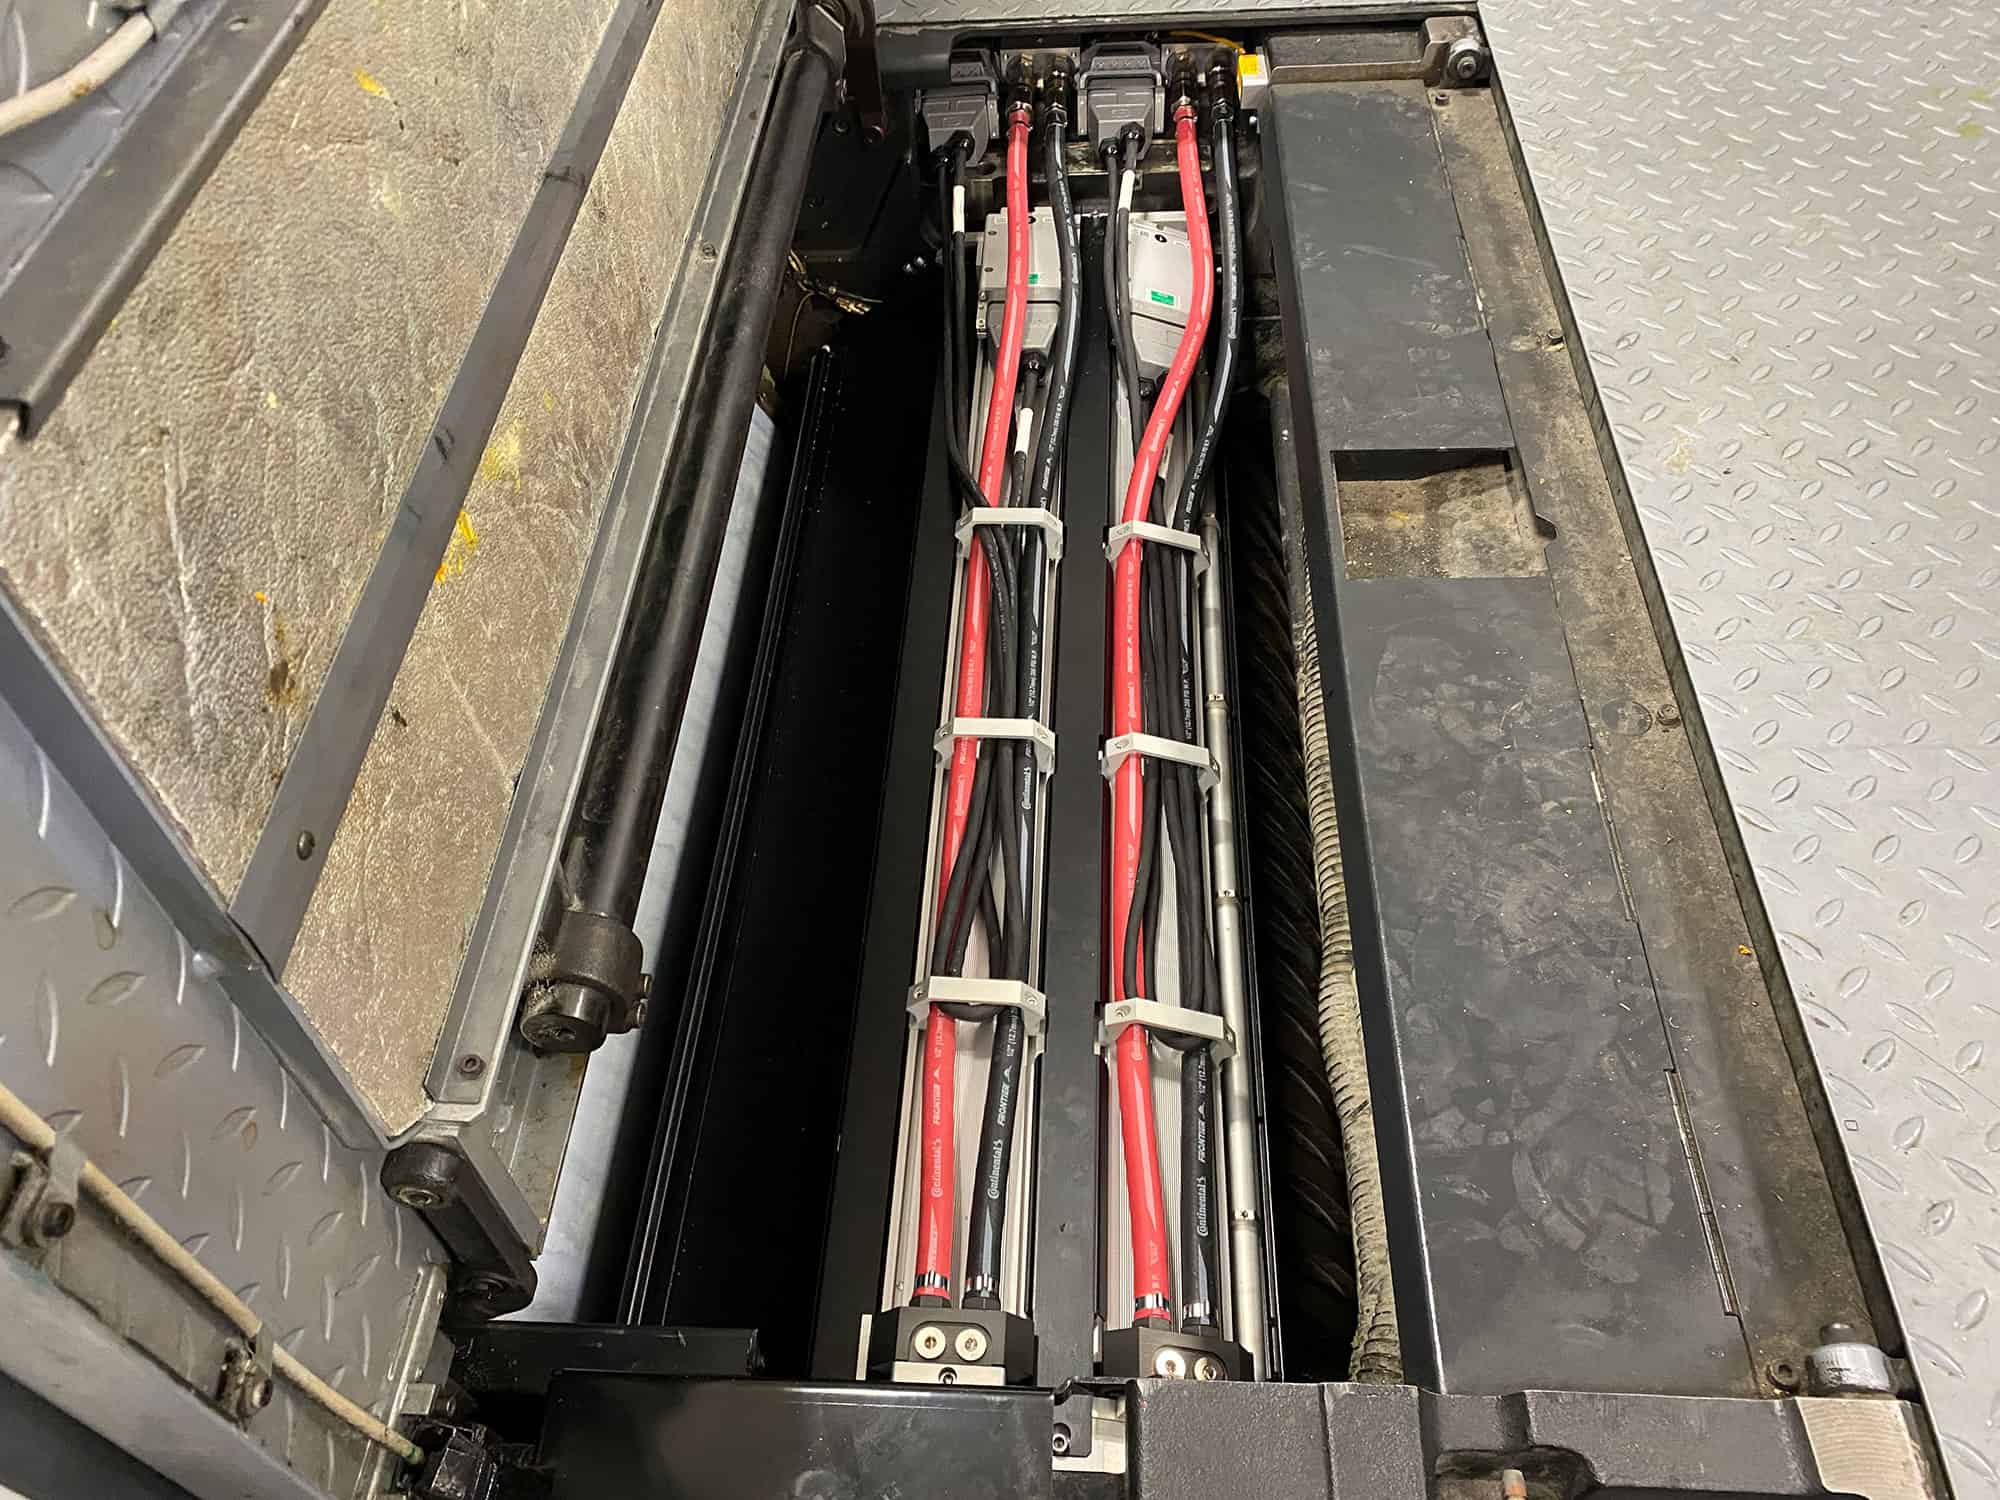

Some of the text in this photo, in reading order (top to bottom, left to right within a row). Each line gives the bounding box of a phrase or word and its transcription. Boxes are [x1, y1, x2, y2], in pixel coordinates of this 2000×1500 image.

[932, 1082, 941, 1125] FRONTIER
[986, 1147, 1003, 1199] Continental
[997, 1081, 1010, 1127] FRONTIER
[1197, 1118, 1206, 1163] FRONTIER
[931, 1144, 944, 1197] Continental
[1197, 1184, 1209, 1237] Continental
